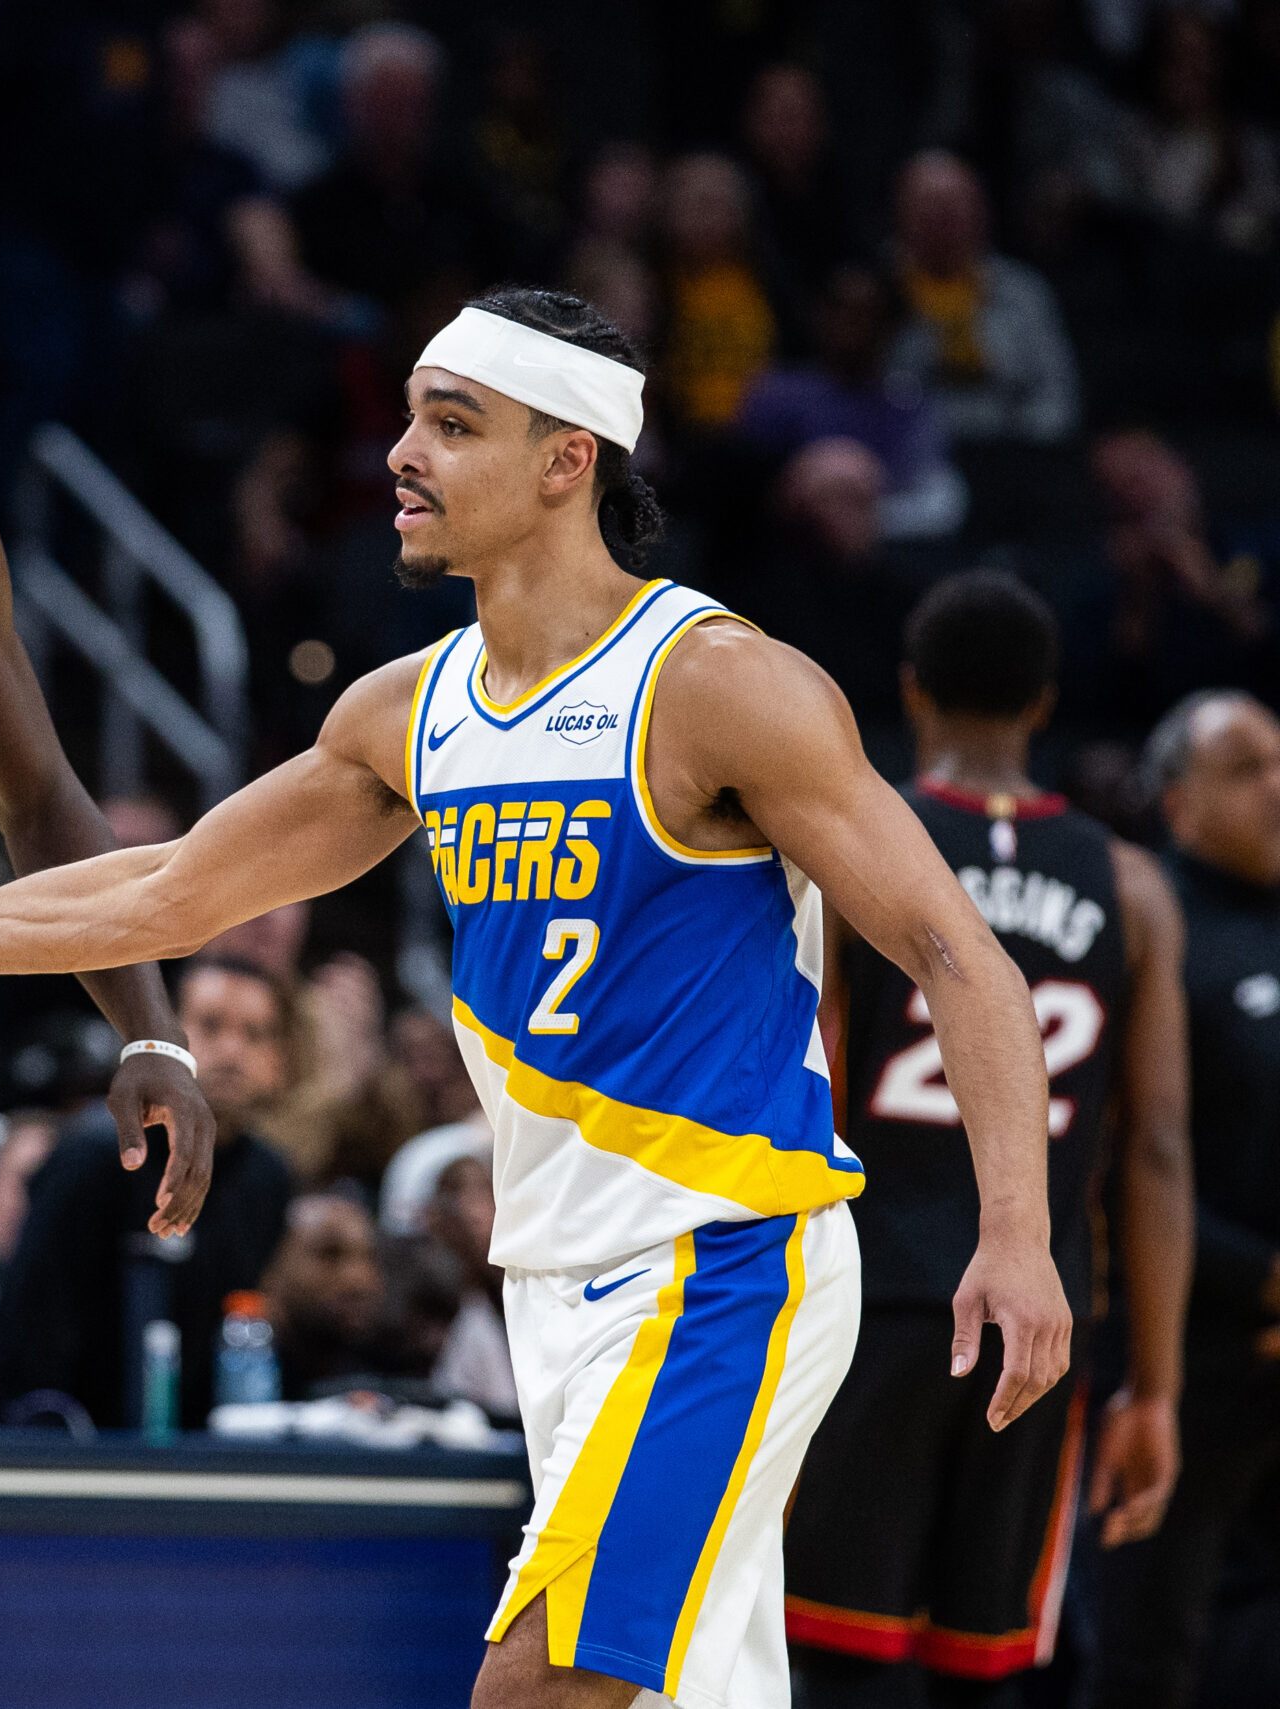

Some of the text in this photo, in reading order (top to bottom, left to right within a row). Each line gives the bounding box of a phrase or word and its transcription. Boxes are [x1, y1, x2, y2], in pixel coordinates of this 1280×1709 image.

[545, 713, 619, 732] LUCAS OIL
[425, 799, 612, 906] PACERS
[957, 865, 1107, 963] GGINS
[528, 918, 600, 1035] 2
